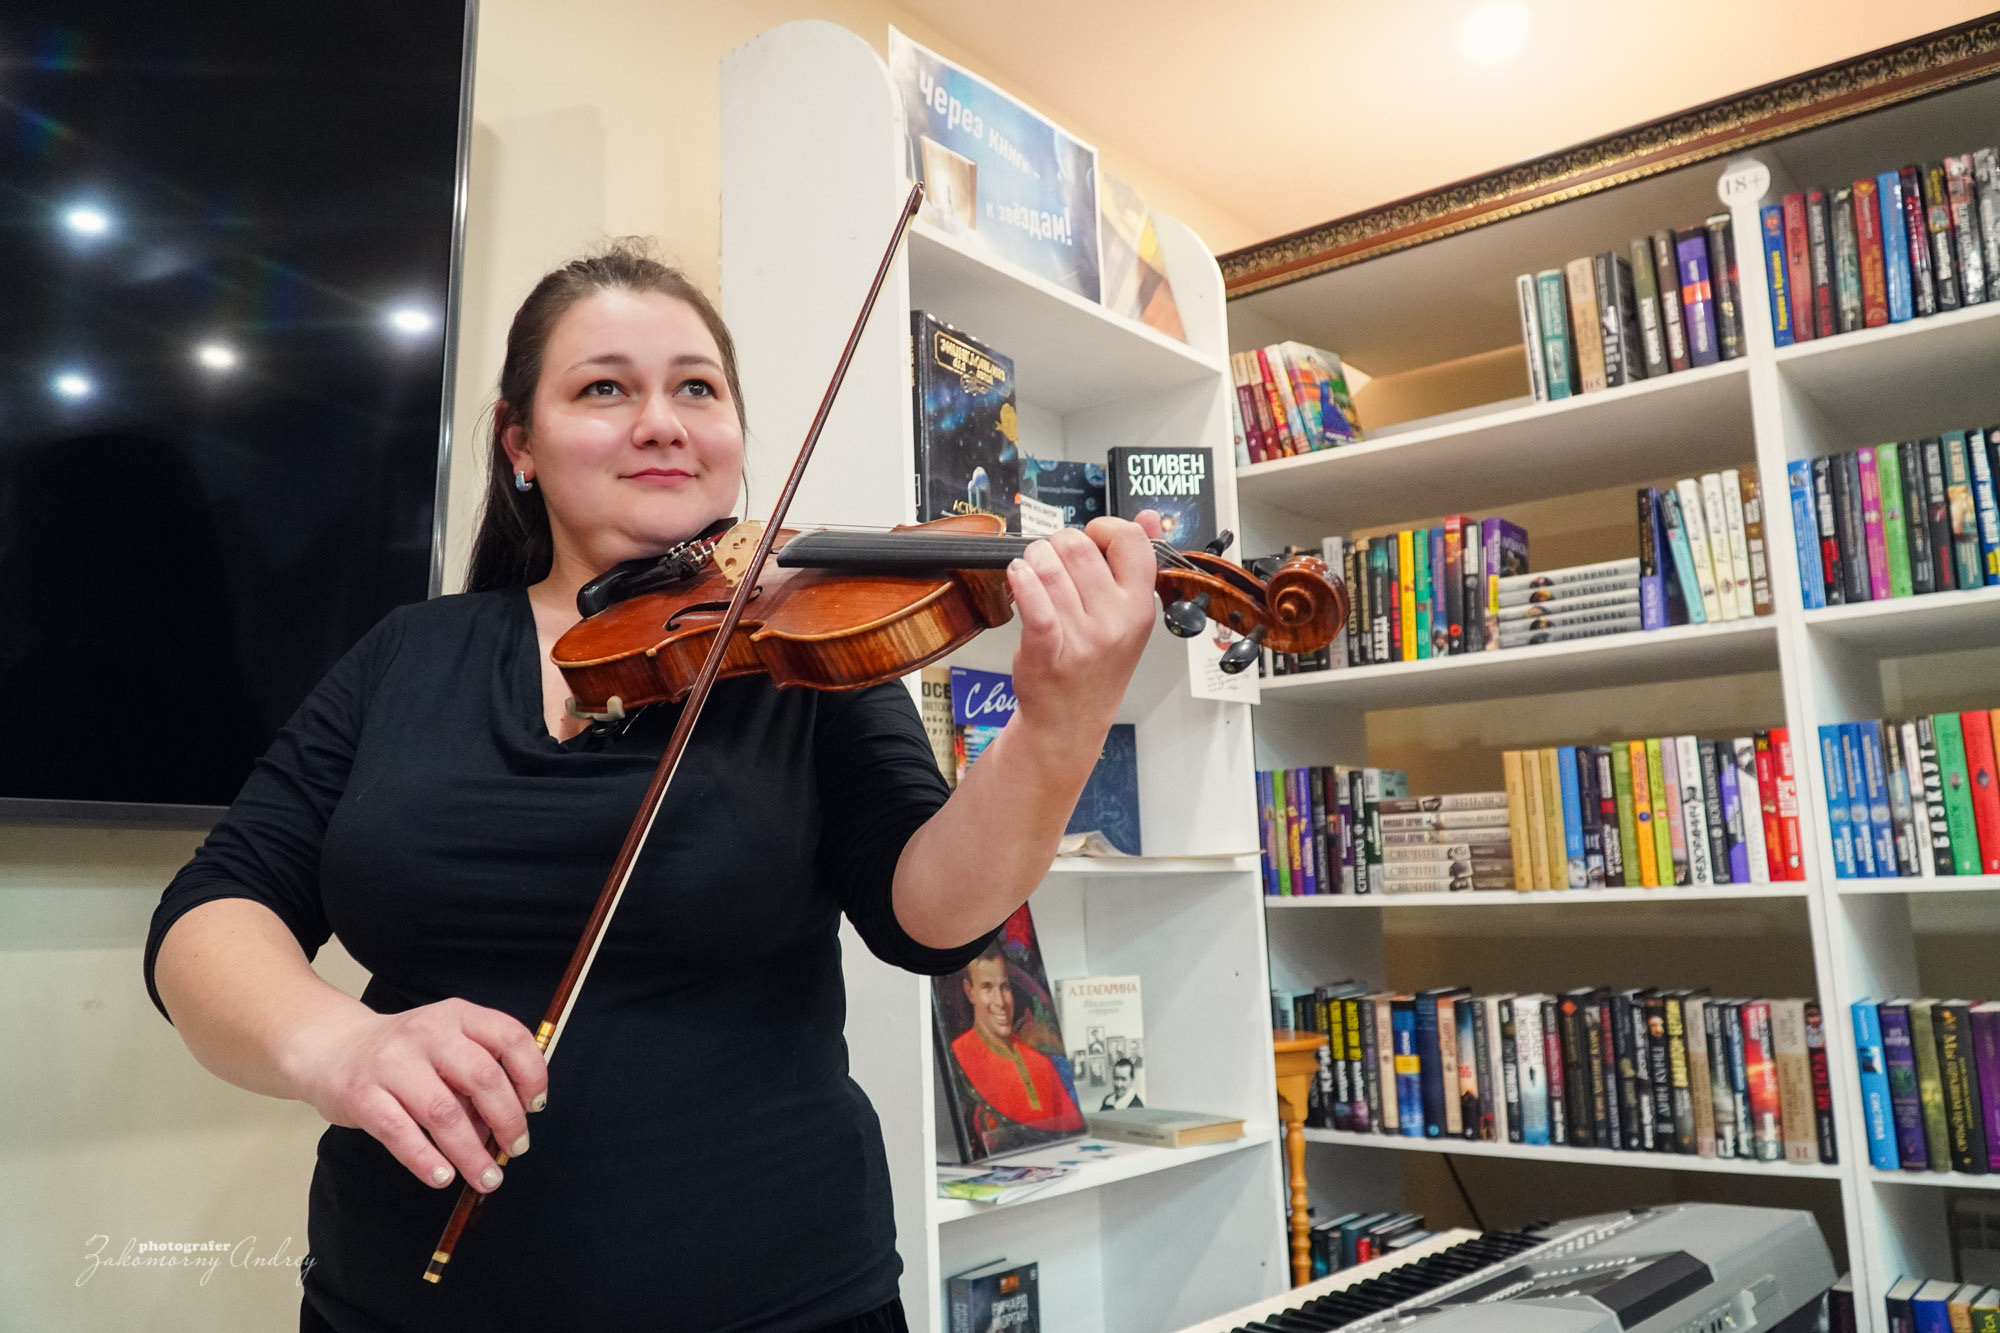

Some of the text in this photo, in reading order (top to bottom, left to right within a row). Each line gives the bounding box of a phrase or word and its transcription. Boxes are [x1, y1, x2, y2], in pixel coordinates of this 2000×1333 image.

[1724, 173, 1764, 196] 18+
[1127, 453, 1205, 475] СТИВЕН
[1128, 474, 1206, 496] ХОКИНГ
[1920, 749, 1950, 848] БЛЭКАУТ
[1354, 838, 1368, 893] СПЕЦНАЗ
[1652, 1046, 1671, 1117] ДИН КУНЦ
